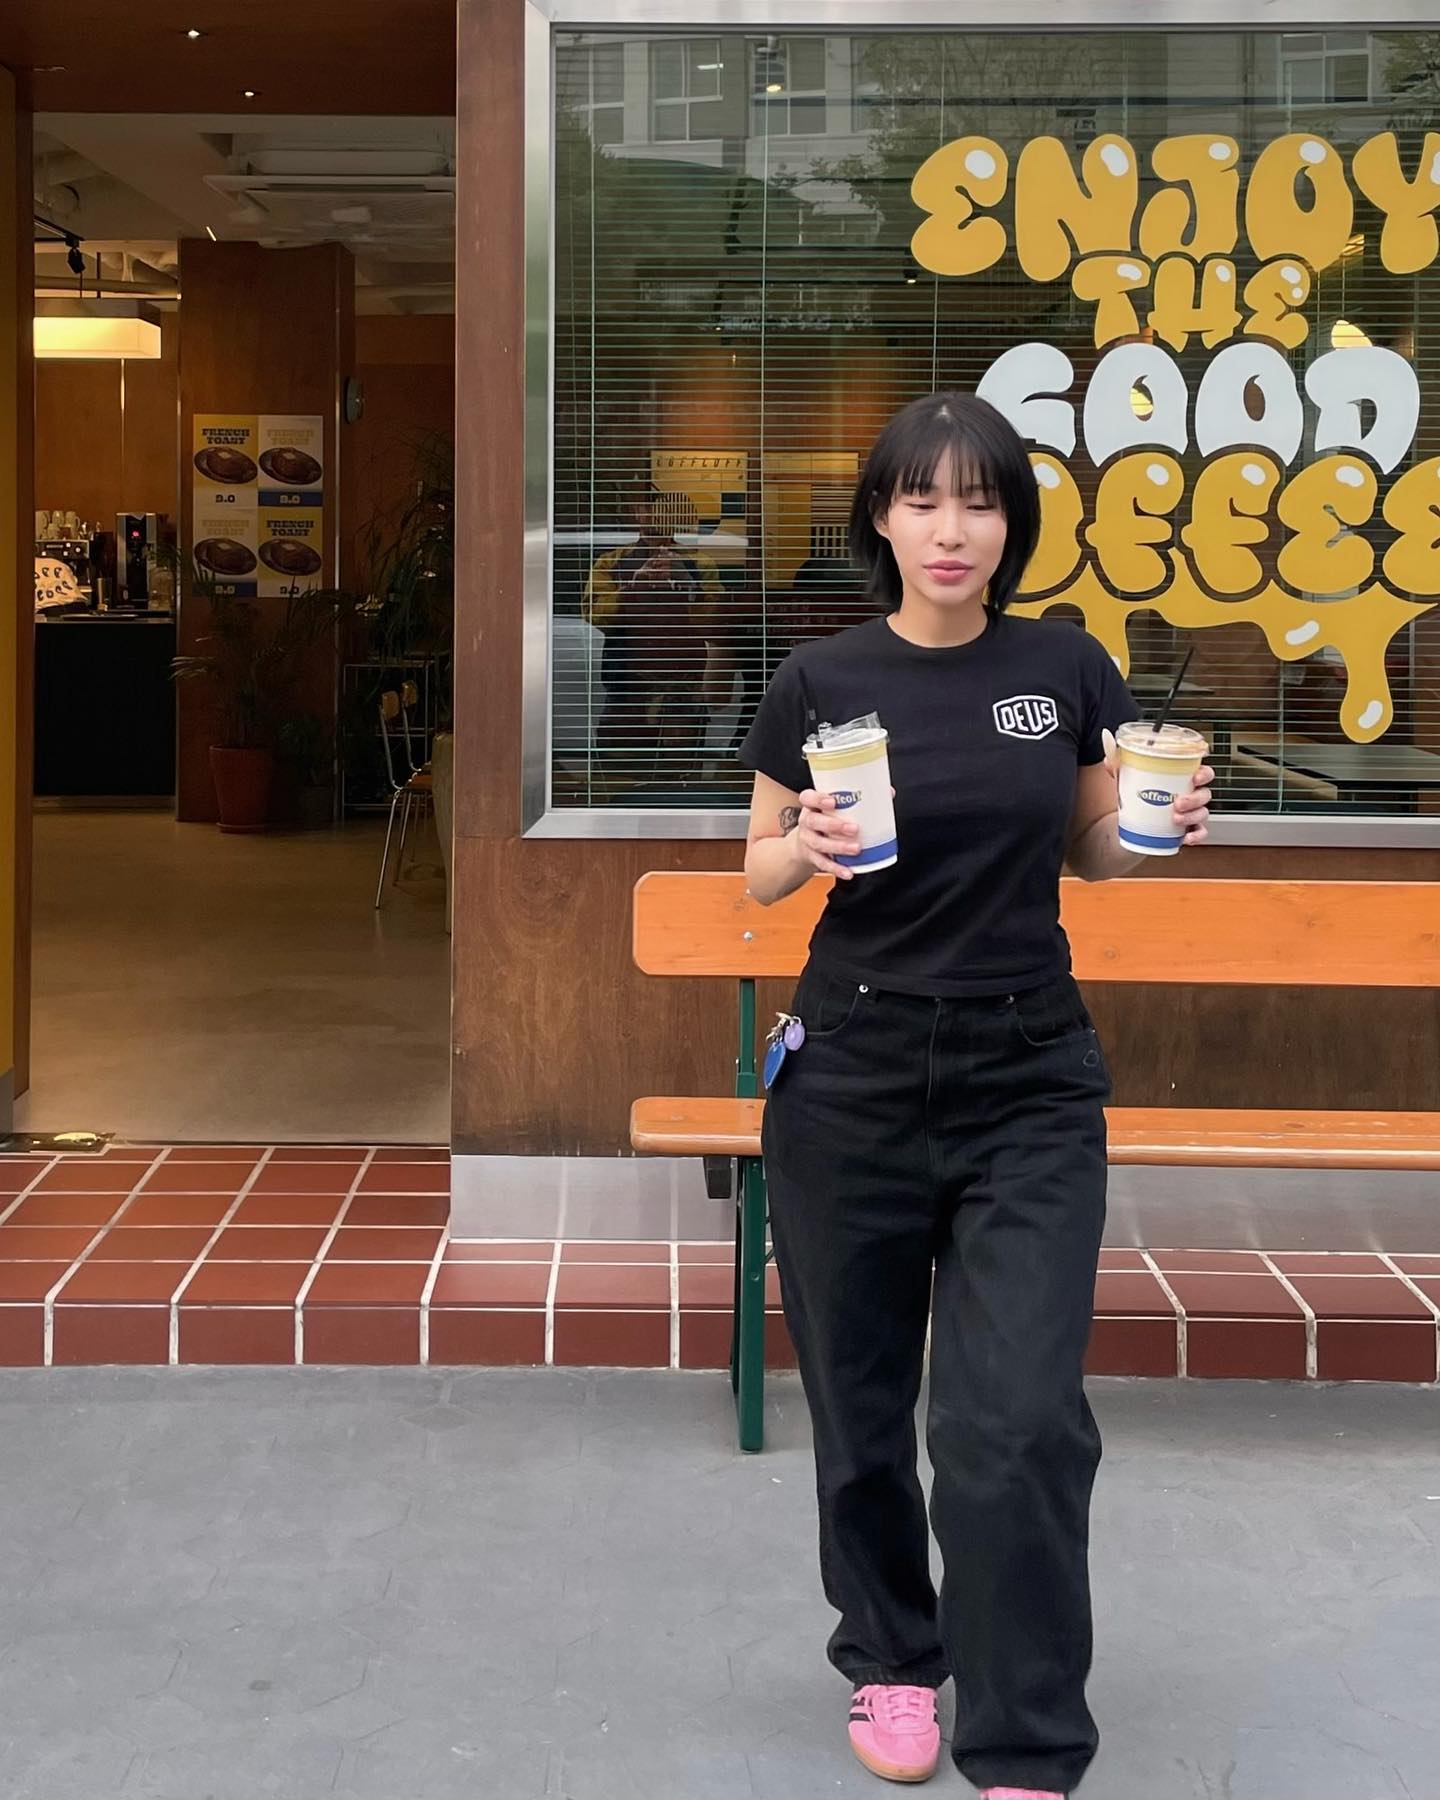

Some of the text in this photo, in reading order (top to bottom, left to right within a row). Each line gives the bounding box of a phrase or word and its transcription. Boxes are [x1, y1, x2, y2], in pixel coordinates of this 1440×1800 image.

[910, 133, 1440, 281] ENJOY
[1072, 256, 1311, 352] THE
[202, 428, 250, 437] FRENCH
[975, 342, 1420, 475] GOOD
[207, 437, 246, 445] TOAST
[266, 520, 314, 529] FRENCH
[271, 529, 310, 537] TOAST
[1020, 452, 1440, 595] OFFEE
